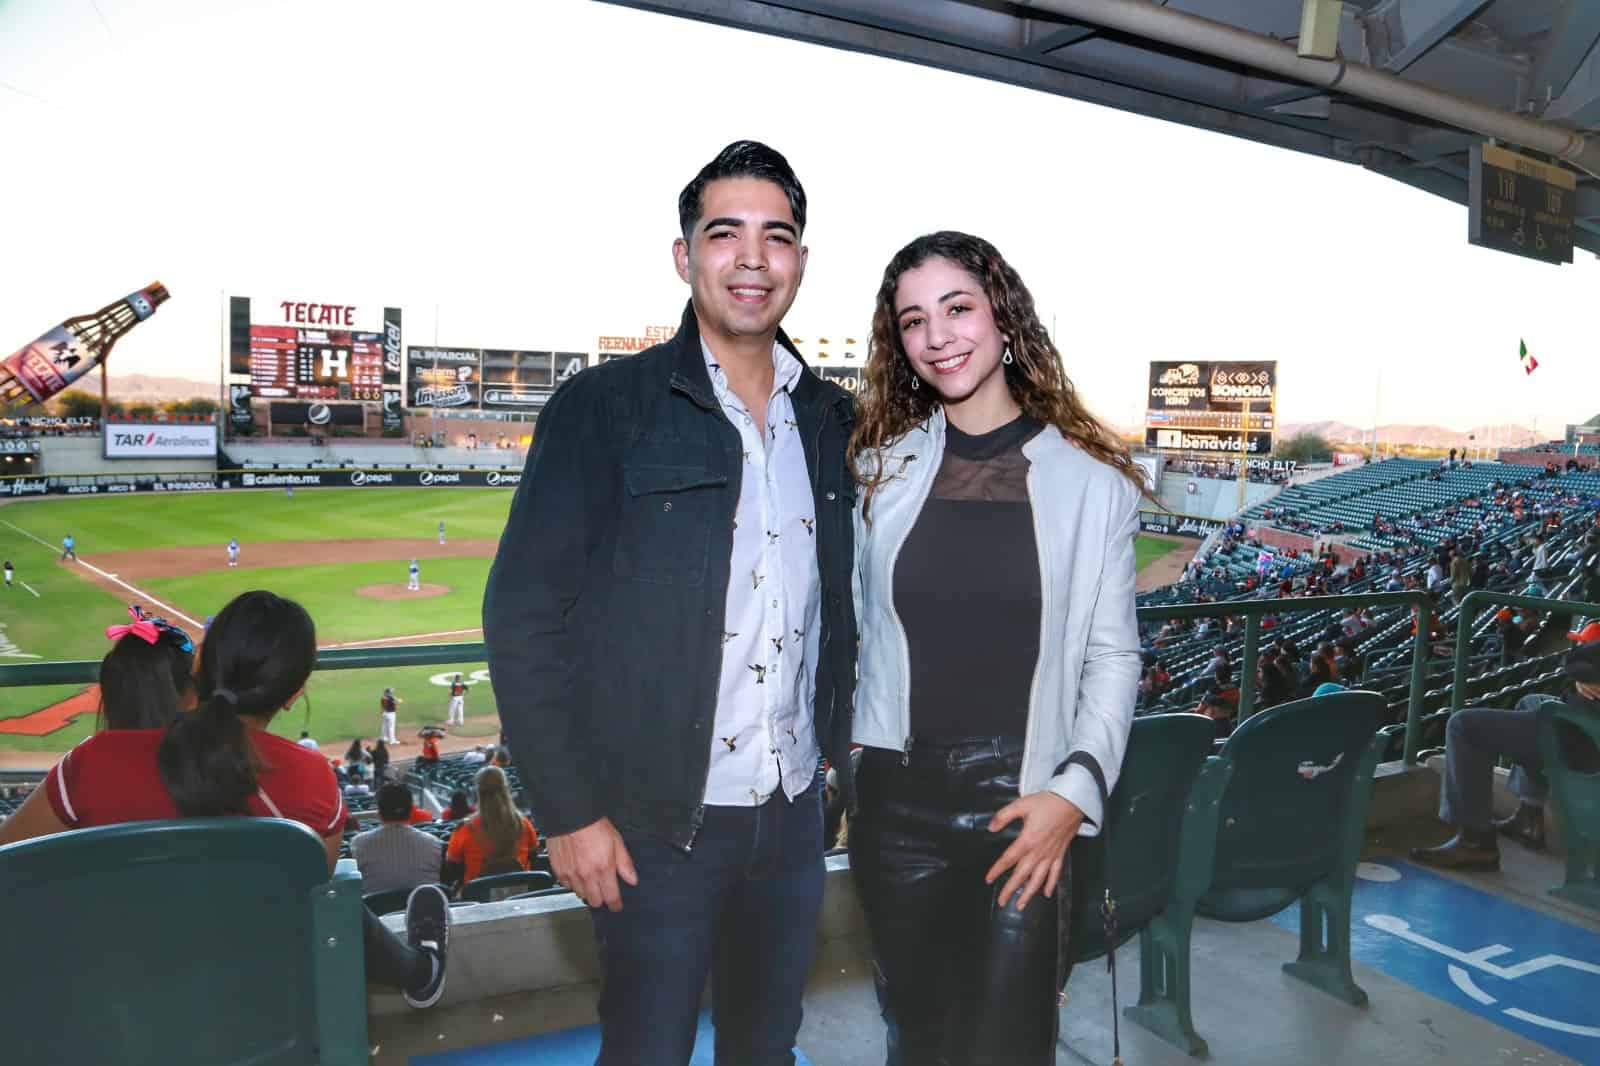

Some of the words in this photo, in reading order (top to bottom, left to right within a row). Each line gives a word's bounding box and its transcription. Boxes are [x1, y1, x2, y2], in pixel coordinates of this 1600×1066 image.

[281, 301, 356, 326] TECATE
[384, 321, 401, 373] telcel
[321, 349, 348, 377] H
[1151, 387, 1206, 398] CONCRETOS
[1211, 384, 1271, 397] SONORA
[114, 433, 145, 447] TAR
[1182, 434, 1258, 451] benavides
[255, 474, 321, 485] caliente.mx
[366, 474, 393, 484] pepsi
[434, 473, 460, 483] pepsi
[500, 474, 521, 484] pep
